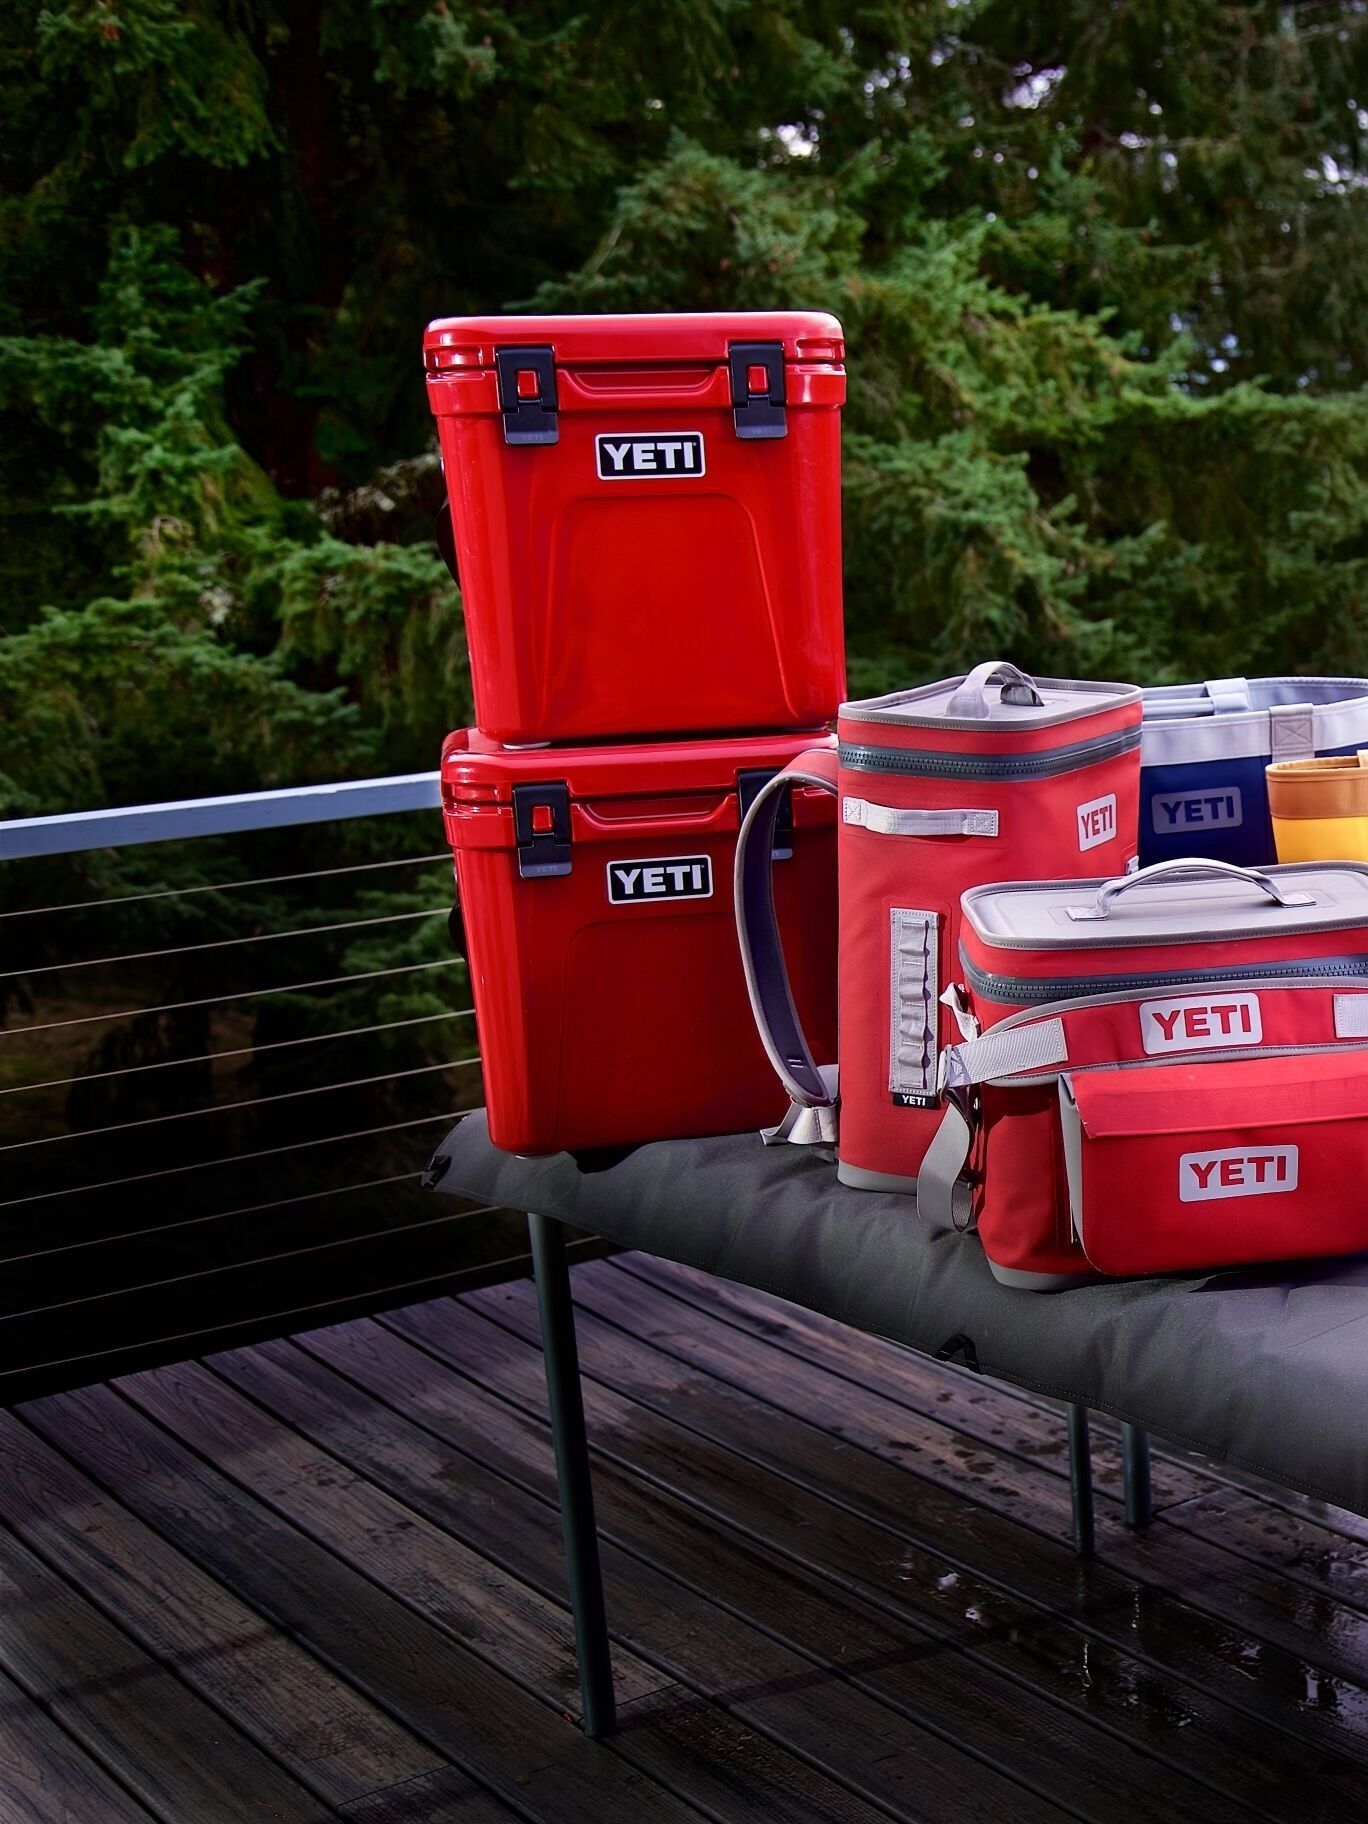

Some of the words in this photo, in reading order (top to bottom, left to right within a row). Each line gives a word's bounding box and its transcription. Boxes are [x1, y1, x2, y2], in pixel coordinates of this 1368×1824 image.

[602, 441, 695, 471] YETI
[1080, 804, 1113, 840] YETI
[1160, 795, 1236, 825] YETI
[613, 864, 703, 895] YETI
[1151, 1003, 1252, 1041] YETI
[901, 1094, 926, 1106] YETI
[1188, 1155, 1287, 1189] YETI
